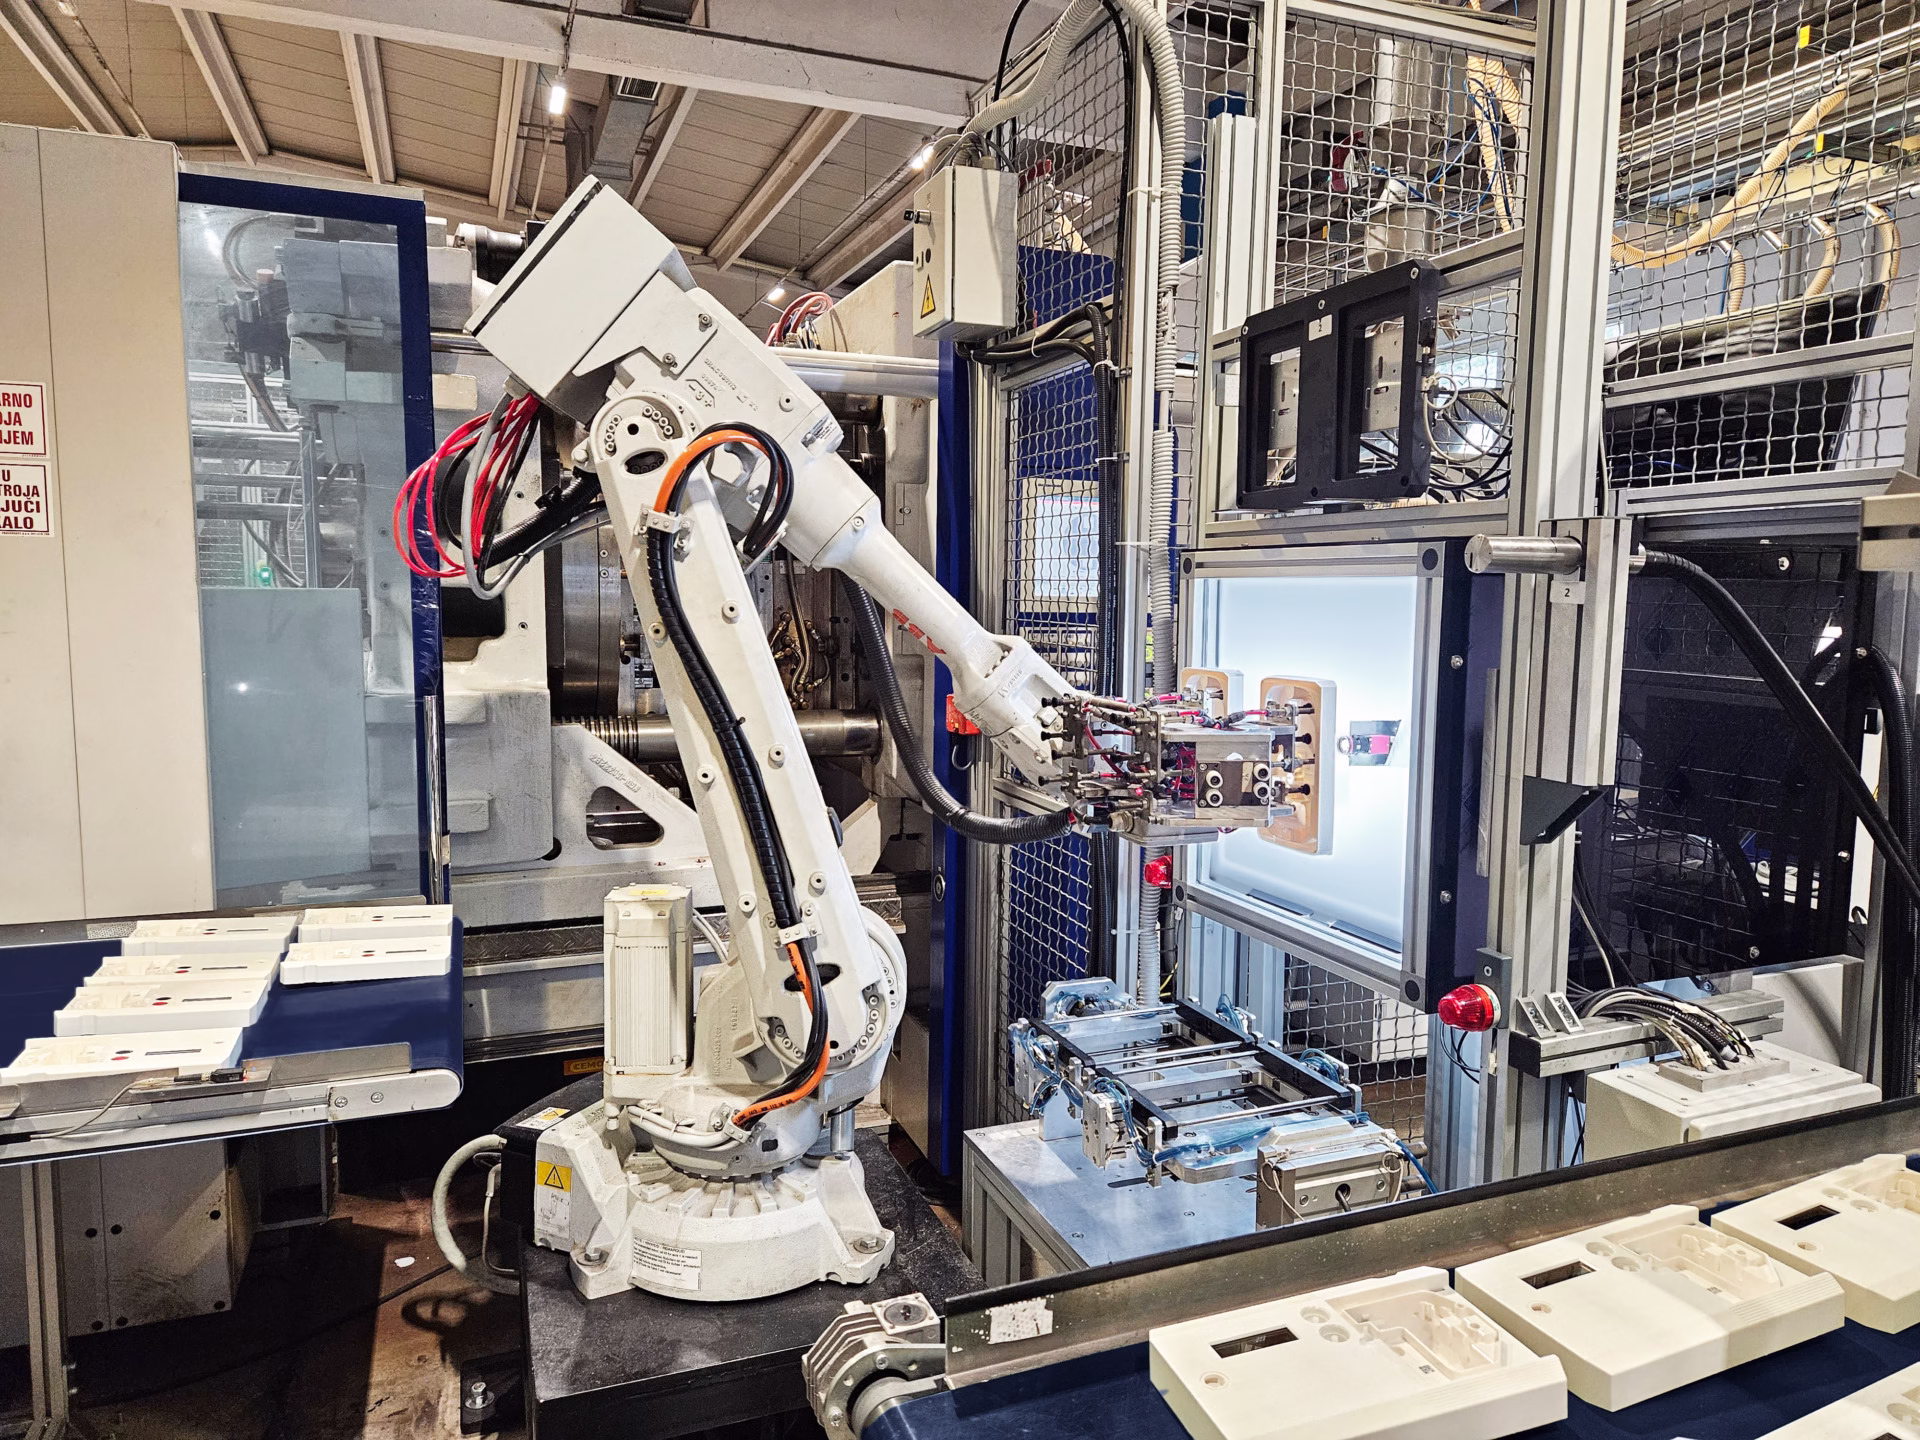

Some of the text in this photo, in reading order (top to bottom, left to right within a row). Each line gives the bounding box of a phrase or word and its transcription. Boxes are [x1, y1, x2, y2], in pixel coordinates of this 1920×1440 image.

[0, 392, 33, 408] RNO
[0, 411, 22, 426] JA
[0, 430, 34, 445] JEM
[2, 469, 10, 482] U
[0, 516, 34, 529] ALO
[1564, 588, 1570, 597] 2
